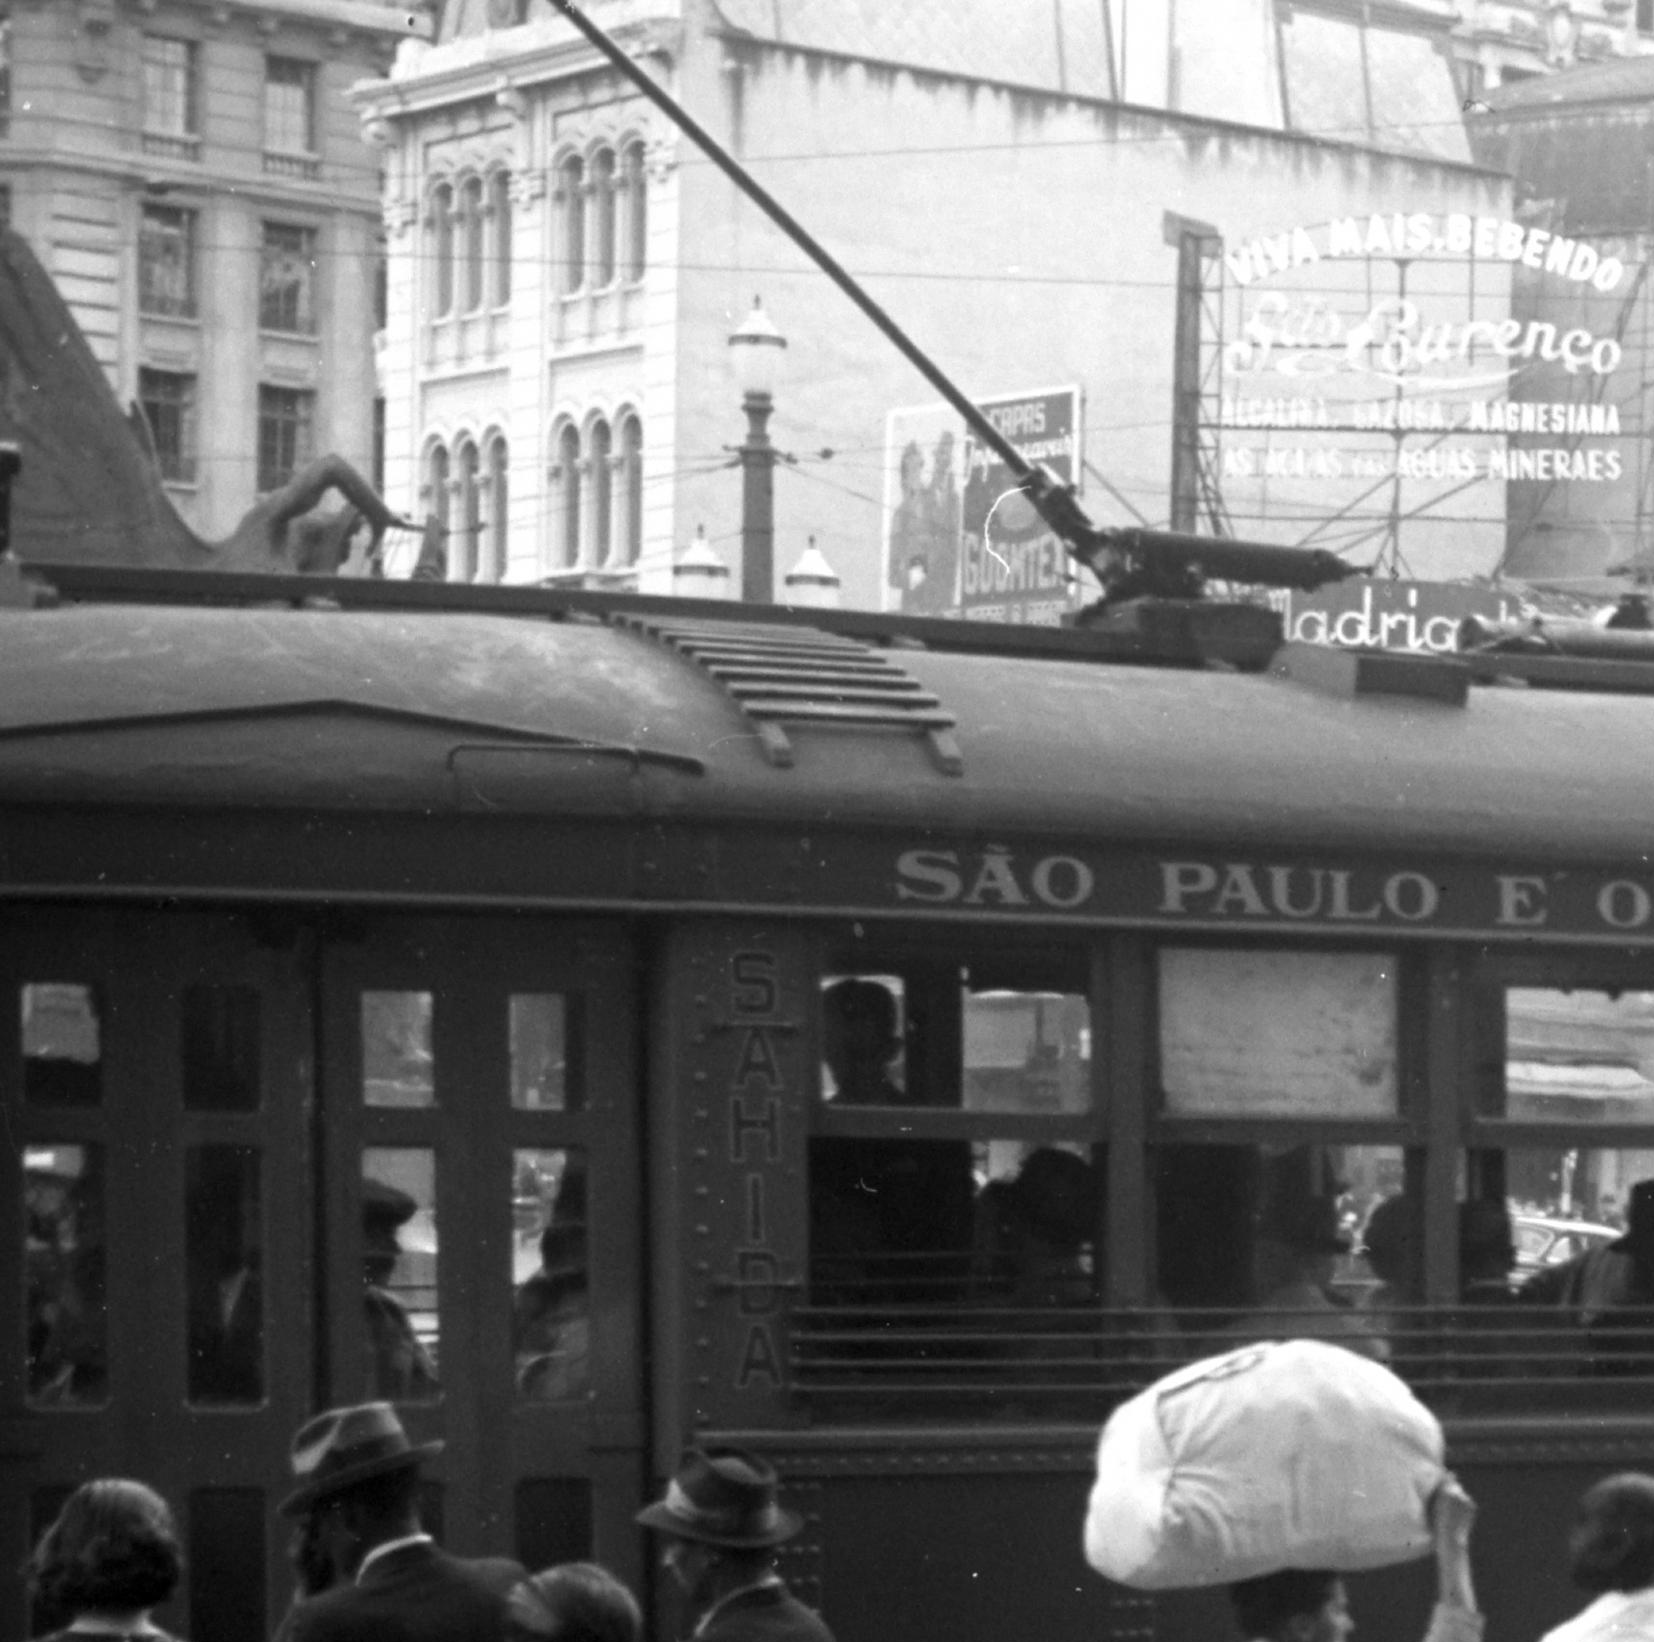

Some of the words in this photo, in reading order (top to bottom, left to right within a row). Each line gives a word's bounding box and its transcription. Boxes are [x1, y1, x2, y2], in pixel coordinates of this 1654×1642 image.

[1224, 226, 1320, 285] VIVA
[1447, 213, 1623, 291] BEBENDO
[1487, 448, 1623, 482] MINERAES
[896, 843, 1095, 908] SÃO
[1157, 861, 1438, 922] PAULO
[1599, 879, 1652, 929] O
